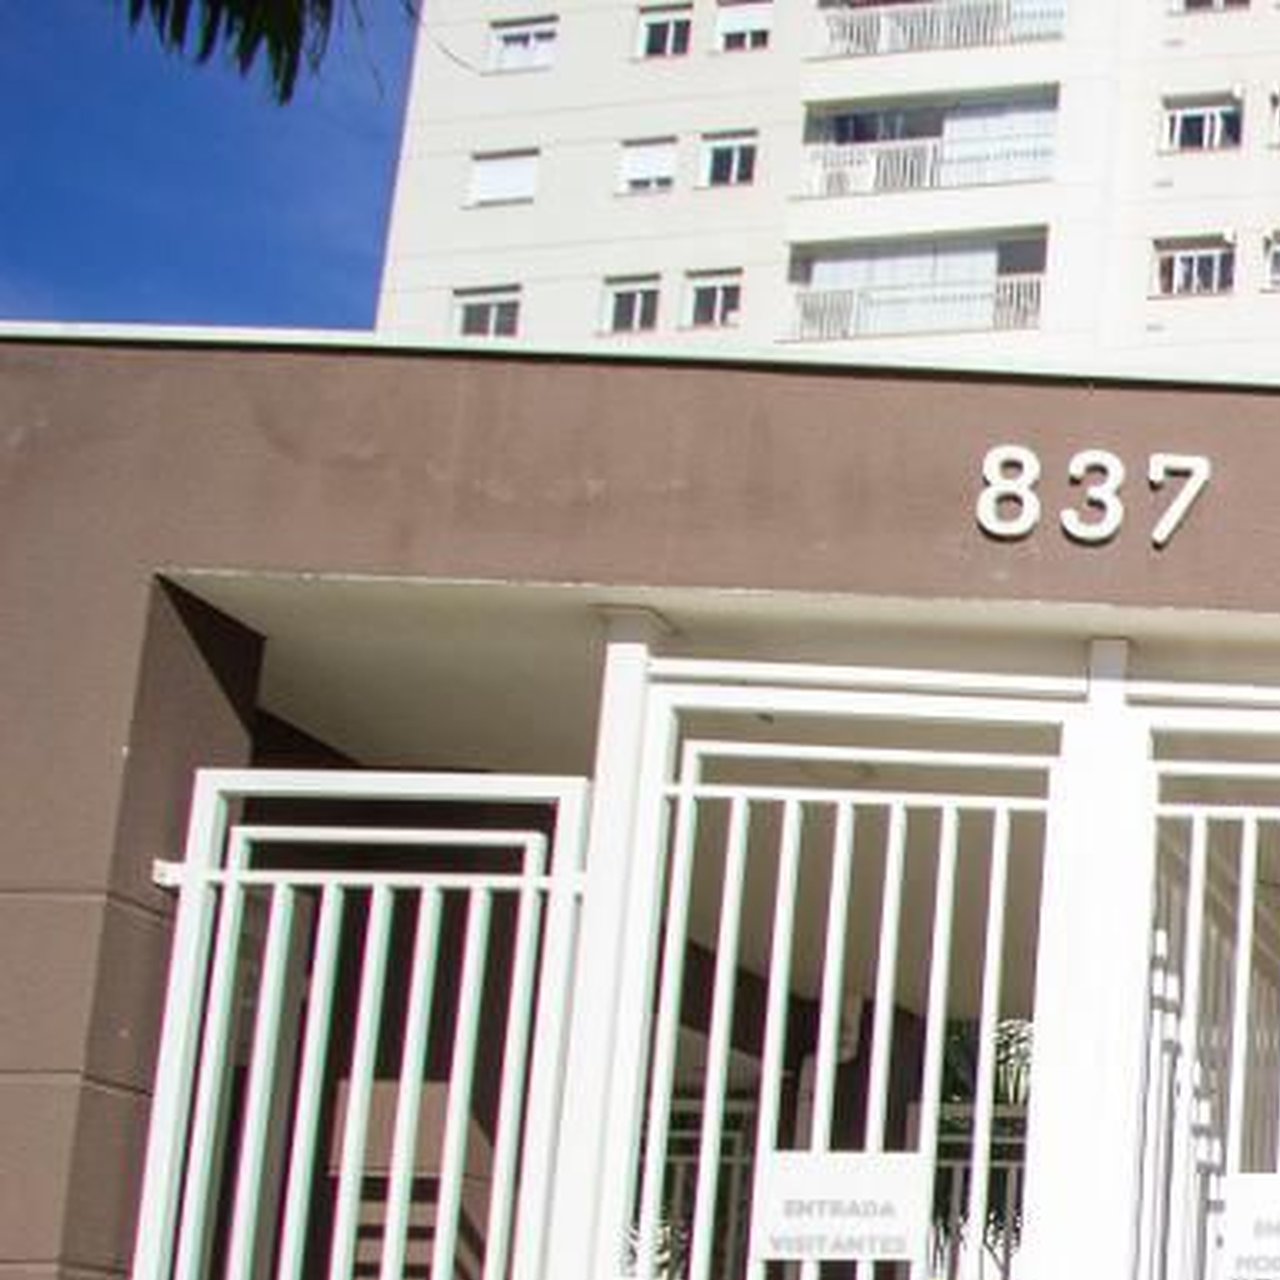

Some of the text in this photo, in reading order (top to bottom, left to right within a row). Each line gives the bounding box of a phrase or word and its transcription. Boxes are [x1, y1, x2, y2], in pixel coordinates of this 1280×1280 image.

[976, 444, 1212, 550] 837
[783, 1198, 899, 1218] ENTRADA
[769, 1234, 908, 1254] VISITANTES
